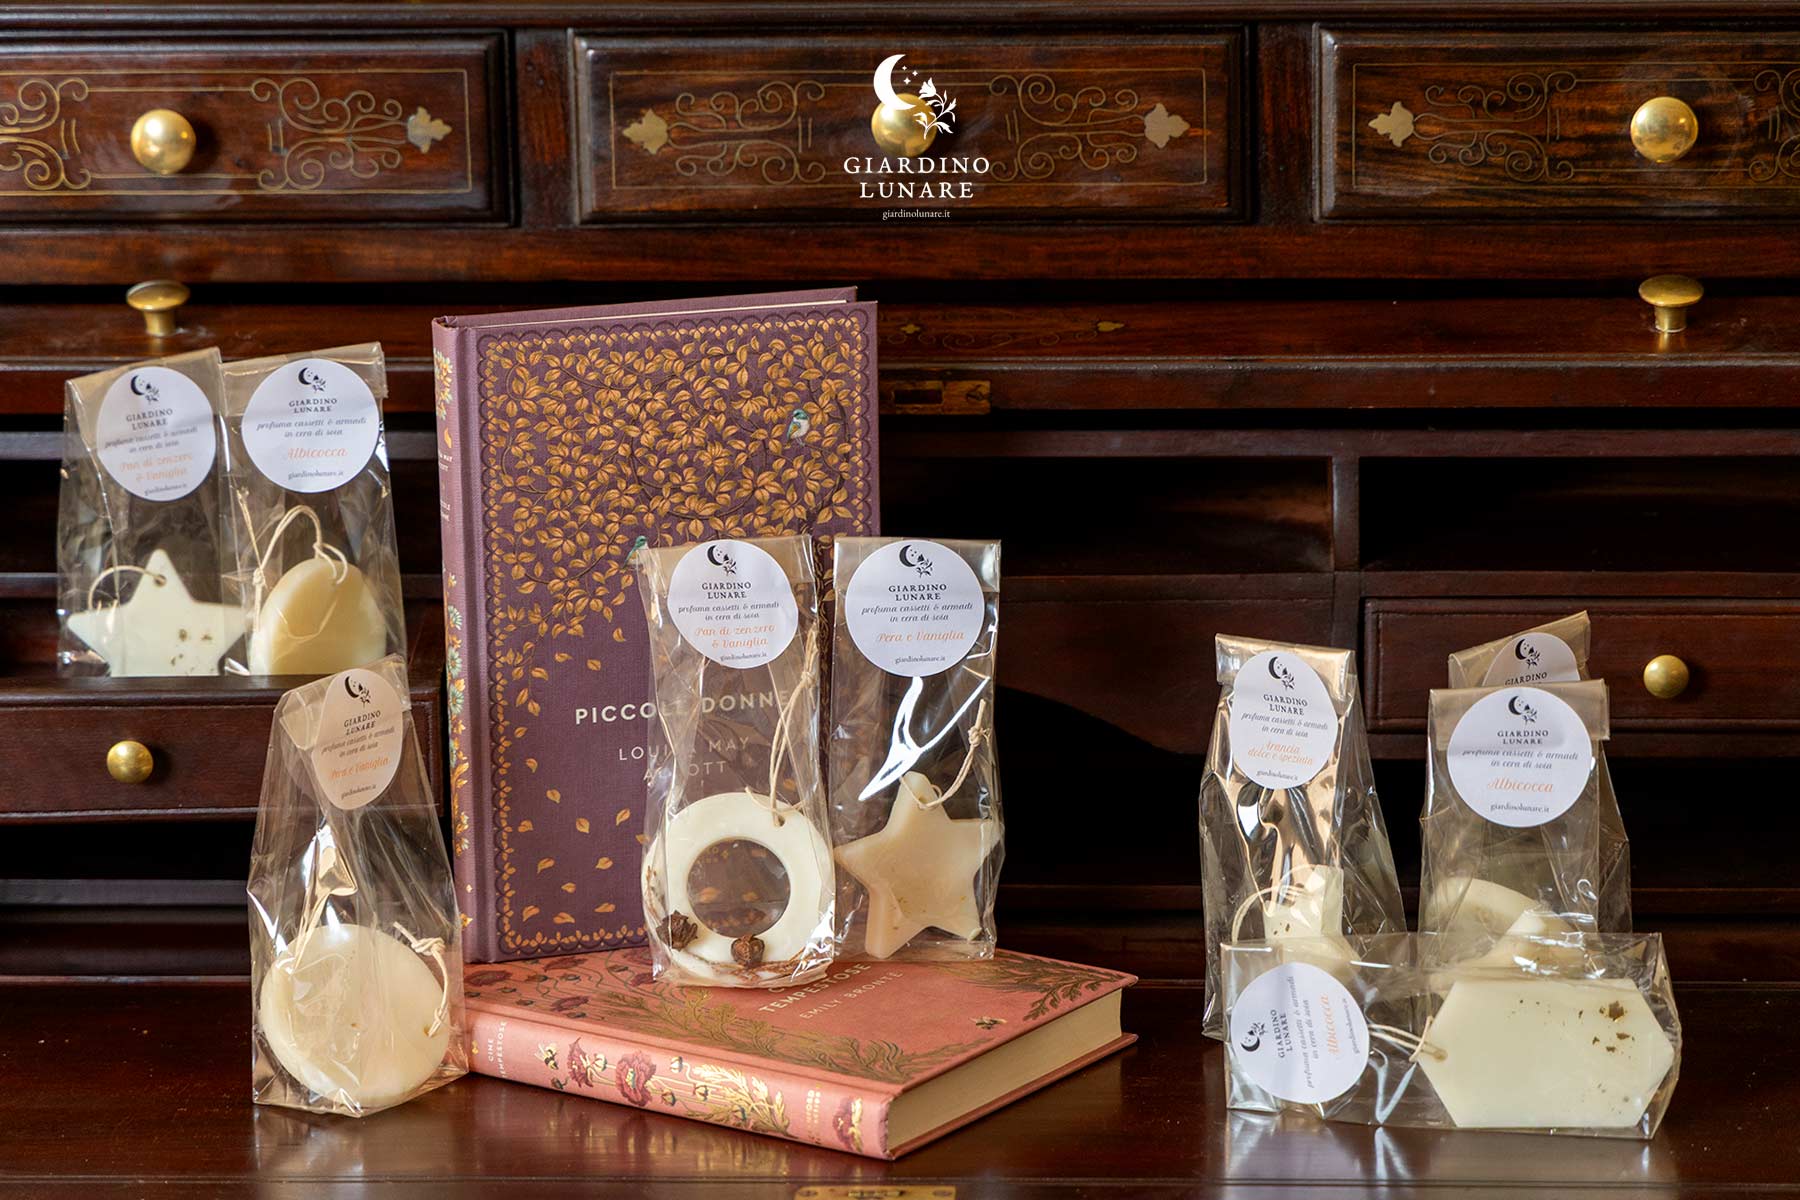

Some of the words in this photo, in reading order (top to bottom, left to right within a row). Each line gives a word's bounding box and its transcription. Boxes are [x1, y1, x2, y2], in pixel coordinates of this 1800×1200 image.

[289, 398, 337, 407] GIARDINO
[126, 408, 173, 422] GIARDINO
[132, 418, 168, 430] LUNARE
[257, 421, 292, 431] profuma
[336, 417, 366, 425] armadi
[288, 448, 347, 459] Albicocca
[702, 582, 751, 590] GIARDINO
[888, 584, 947, 592] GIARDINO
[895, 593, 941, 601] LUNARE
[678, 604, 710, 613] profuma
[750, 601, 779, 609] armadi
[861, 605, 897, 615] profuma
[900, 604, 930, 612] cassetti
[941, 602, 973, 611] armadi
[695, 628, 715, 636] Pan
[720, 626, 729, 635] di
[735, 624, 775, 634] zenzero
[722, 637, 768, 648] Vaniglia
[878, 633, 902, 643] Pera
[917, 631, 964, 642] Vaniglia
[895, 655, 945, 664] giardinolunare.it
[1504, 671, 1548, 686] GIARDINO
[701, 690, 790, 714] DONNE
[1263, 694, 1308, 706] GIARDINO
[1269, 704, 1304, 716] LUNARE
[344, 710, 381, 728] GIARDINO
[1241, 712, 1270, 721] profuma
[1271, 716, 1295, 726] cassetti
[1304, 721, 1328, 730] armadi
[346, 720, 376, 736] LUNARE
[708, 736, 750, 753] MAY
[1502, 749, 1534, 758] cassetti
[1545, 751, 1579, 761] armadi
[643, 760, 727, 781] AOTT
[1522, 760, 1531, 768] di
[1488, 777, 1554, 793] Albicocca
[1490, 803, 1549, 813] giardinolunare.it
[758, 963, 871, 1013] TEMPESTOSE
[1287, 976, 1299, 1007] armadi
[800, 998, 842, 1019] EMILY
[1305, 1018, 1313, 1028] di
[1270, 1010, 1285, 1058] GIARDINO
[1280, 1012, 1293, 1052] LUNARE
[1296, 1019, 1307, 1050] cassetti
[1308, 1030, 1316, 1048] cera
[1302, 1052, 1314, 1088] profuma
